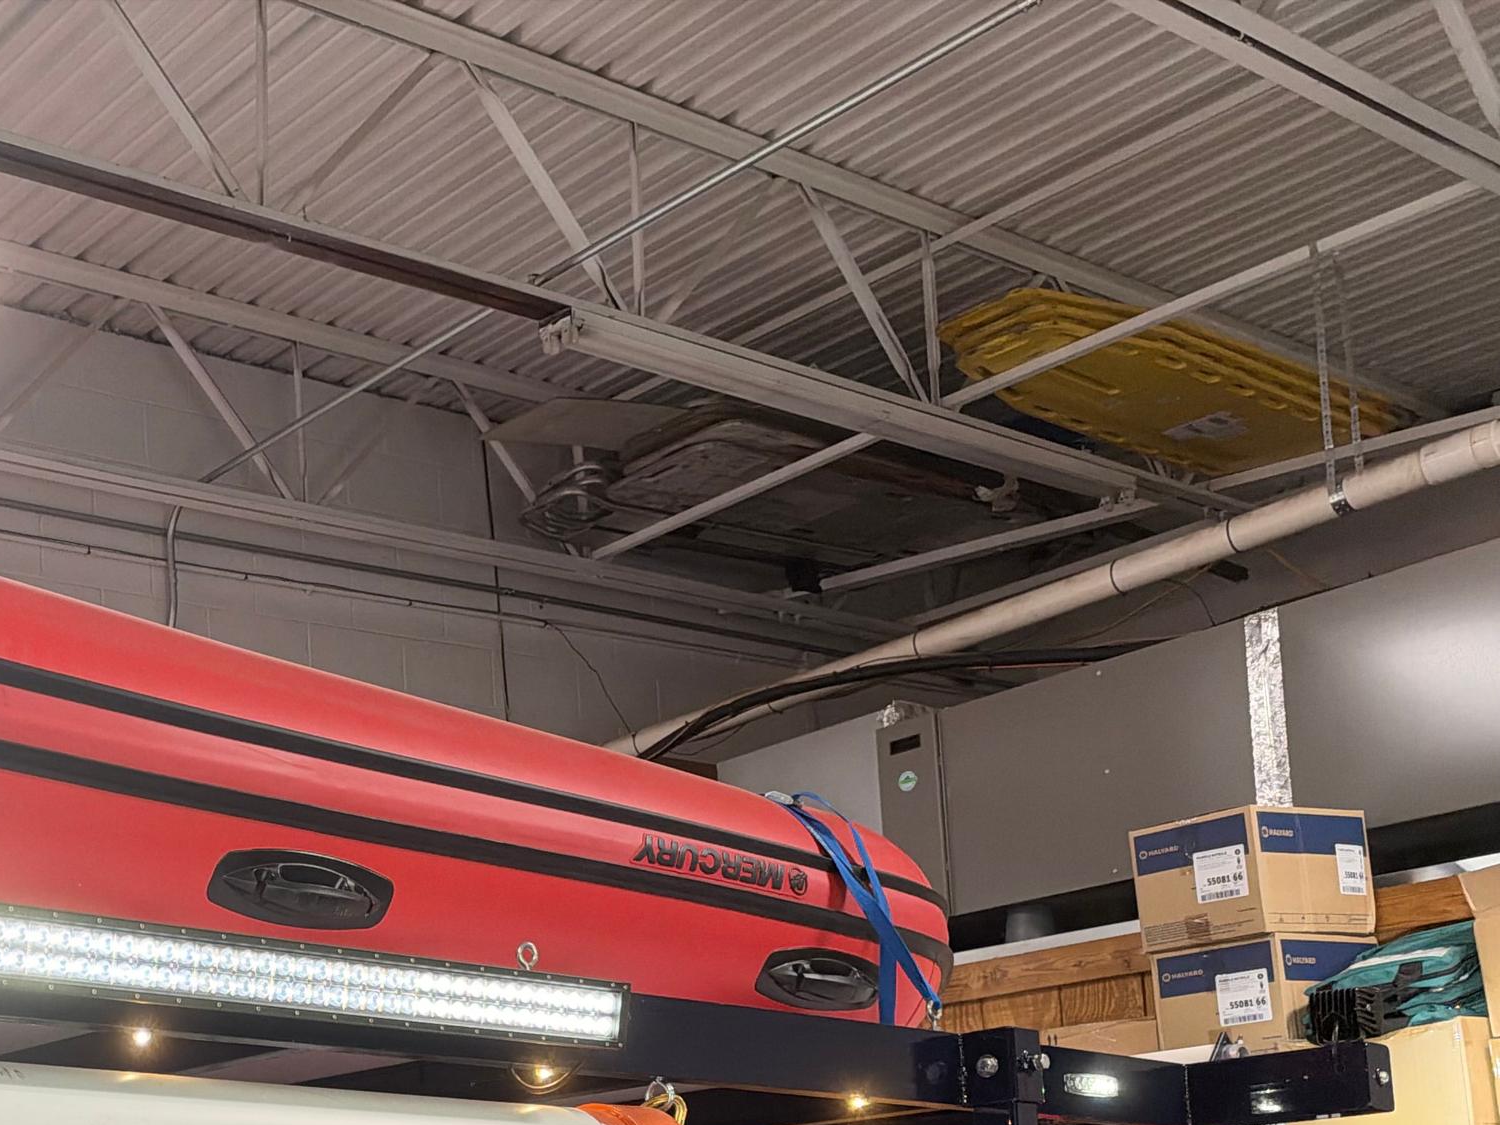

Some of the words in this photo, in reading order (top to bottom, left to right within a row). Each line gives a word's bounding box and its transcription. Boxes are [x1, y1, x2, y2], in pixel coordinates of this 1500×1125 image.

[632, 834, 785, 890] MERCURY
[1207, 874, 1231, 886] 55081
[1232, 872, 1243, 882] 66
[1229, 998, 1254, 1010] 55081
[1255, 996, 1267, 1006] 66
